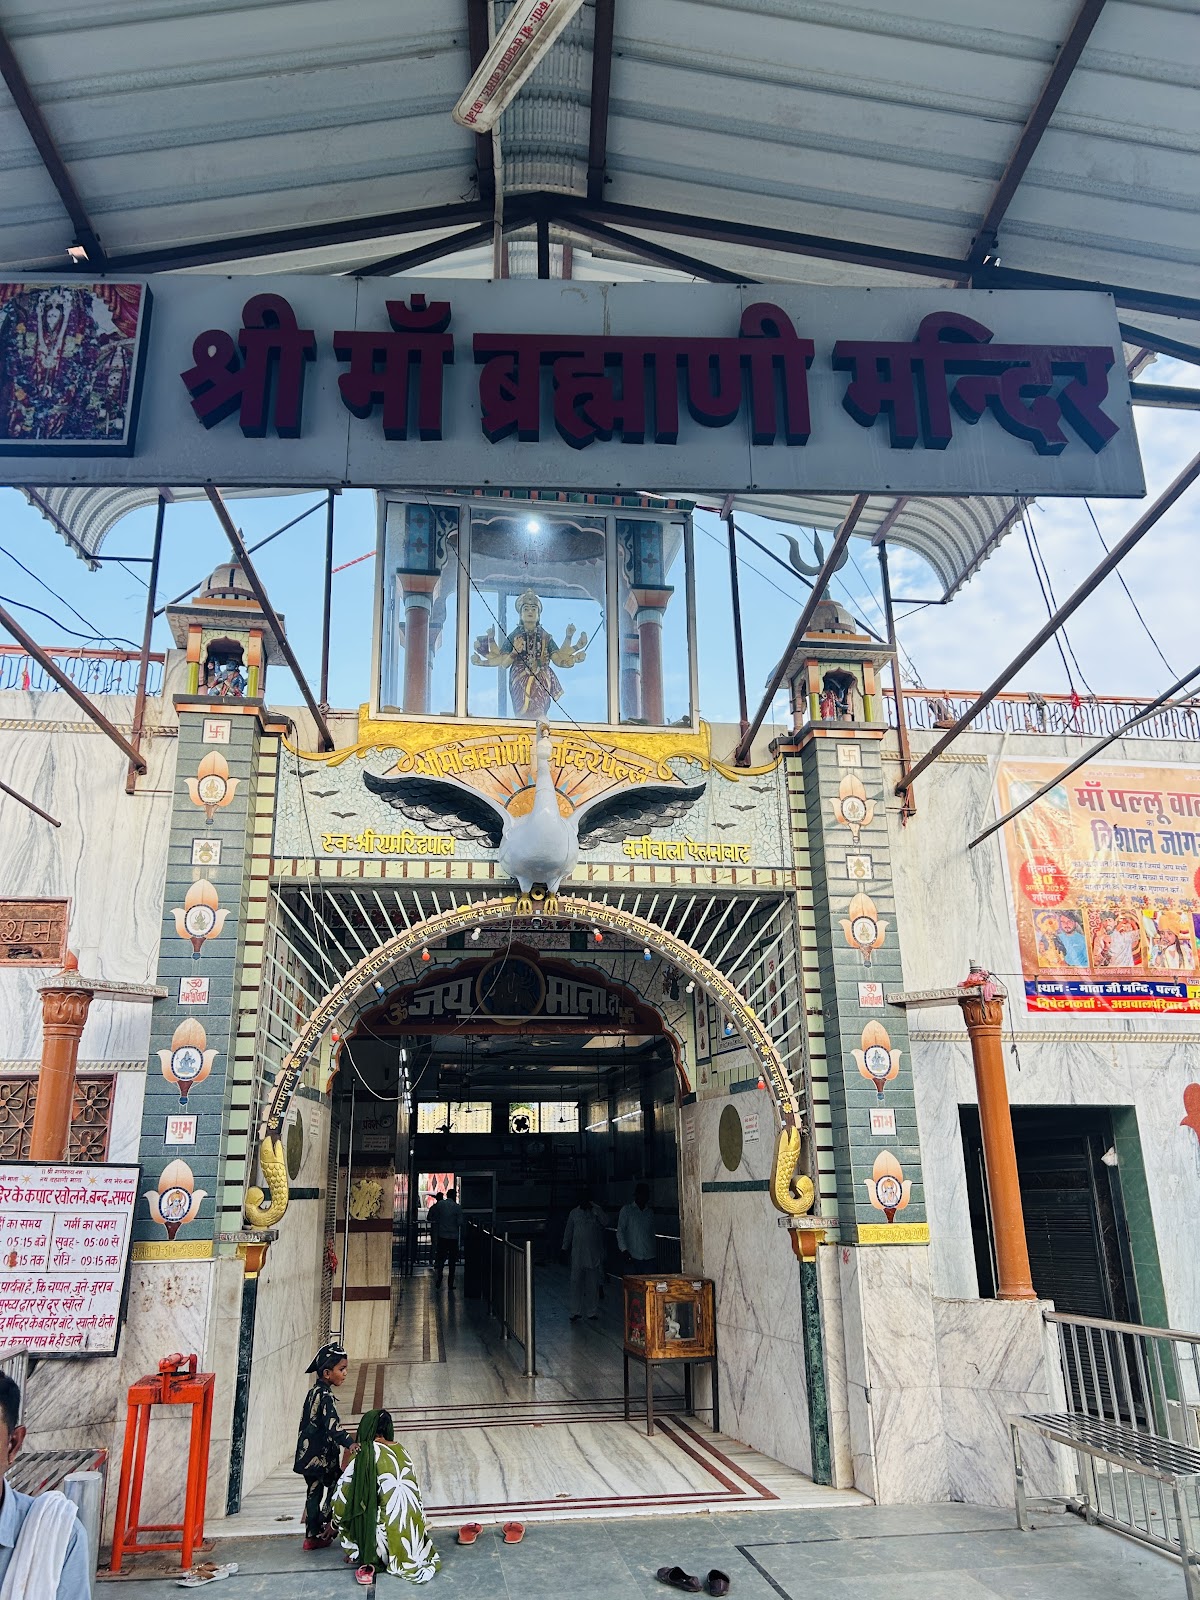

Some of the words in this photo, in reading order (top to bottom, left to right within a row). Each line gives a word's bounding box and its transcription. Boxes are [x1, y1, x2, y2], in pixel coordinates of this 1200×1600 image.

[180, 292, 317, 440] श्री
[472, 302, 815, 450] ब्रह्माणी
[831, 310, 1120, 456] मन्दिर
[416, 748, 444, 778] श्री
[462, 734, 533, 770] ब्रह्माणी
[1108, 788, 1172, 825] पल्लू
[622, 834, 685, 861] बनीवाला
[685, 835, 751, 863] ऐलनाबाद
[408, 977, 474, 1016] जय
[546, 975, 609, 1016] माता
[608, 993, 622, 1016] दी
[1079, 984, 1105, 994] माता
[1106, 982, 1121, 994] जी
[1155, 984, 1182, 998] पल्लू
[169, 1120, 193, 1140] शुभ
[873, 1114, 893, 1128] लाभ
[12, 1185, 24, 1204] के
[25, 1188, 54, 1205] कपाट
[89, 1189, 110, 1207] बन्द
[112, 1189, 135, 1206] समय
[7, 1219, 18, 1230] का
[19, 1219, 42, 1230] समय
[82, 1219, 94, 1231] का
[95, 1219, 117, 1232] समय
[7, 1236, 32, 1248] 05:15
[34, 1234, 47, 1248] बजे
[84, 1237, 109, 1248] 05:00
[111, 1235, 120, 1248] से
[3, 1254, 28, 1267] 0:15
[30, 1254, 45, 1267] तक
[80, 1255, 104, 1266] 09:15
[104, 1254, 119, 1267] तक
[37, 1295, 48, 1313] से
[47, 1298, 61, 1316] दूर
[6, 1313, 28, 1332] मन्दिर
[76, 1314, 97, 1332] खाली
[56, 1332, 65, 1349] ही
